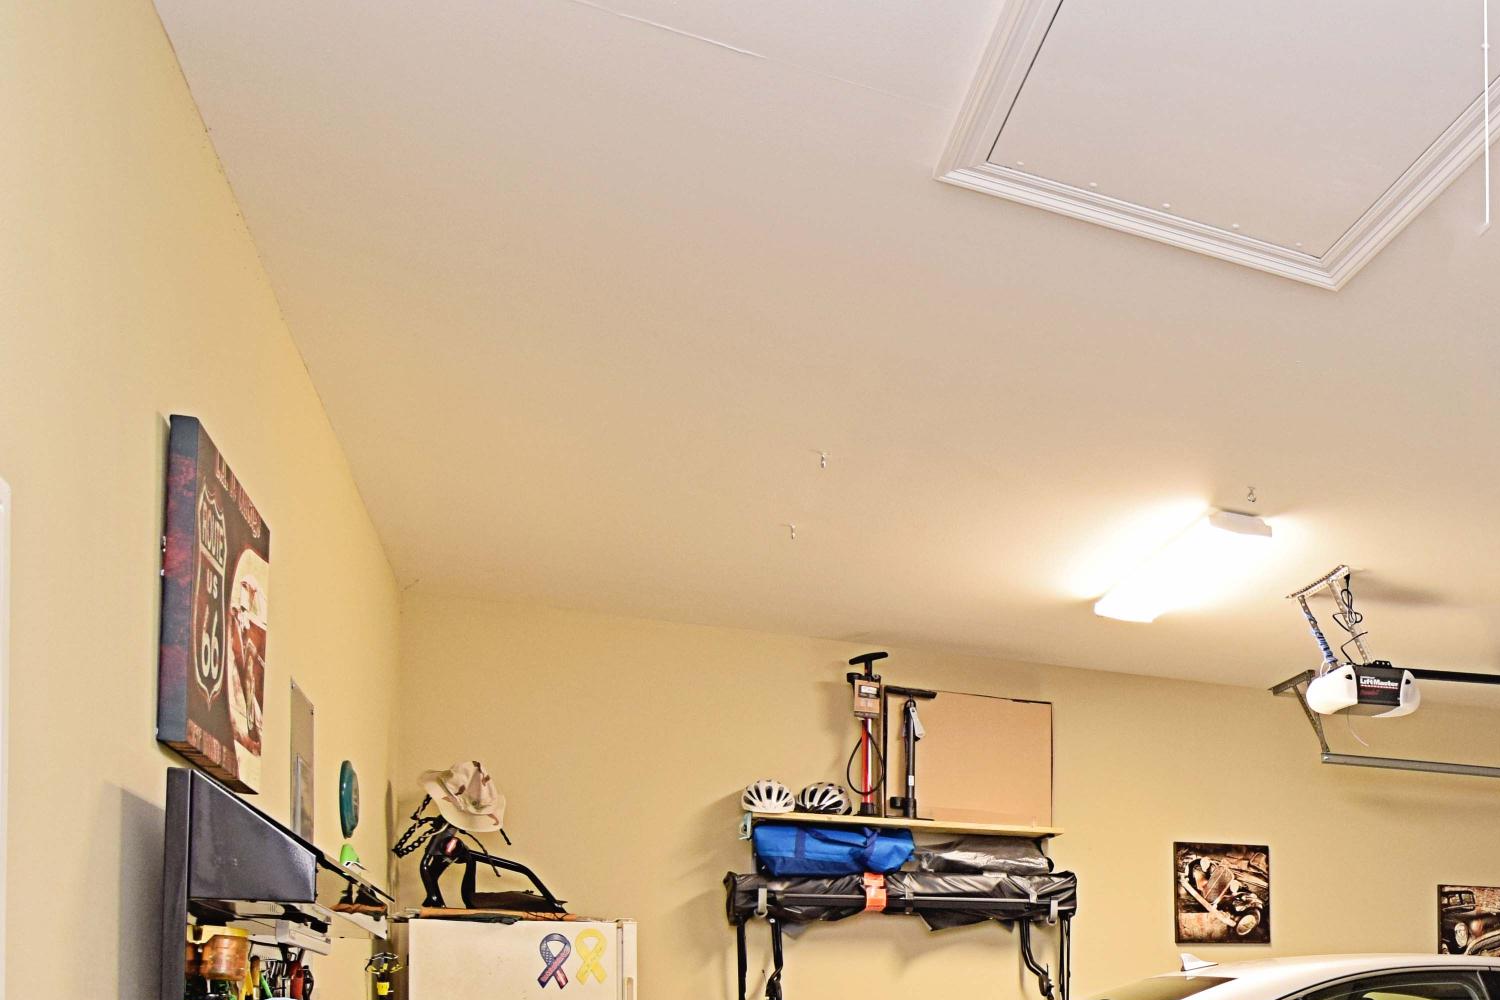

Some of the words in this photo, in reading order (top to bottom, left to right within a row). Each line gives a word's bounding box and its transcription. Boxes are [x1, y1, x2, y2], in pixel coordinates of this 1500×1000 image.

[201, 501, 225, 566] ROUTE
[206, 568, 219, 600] US
[201, 604, 220, 680] 66
